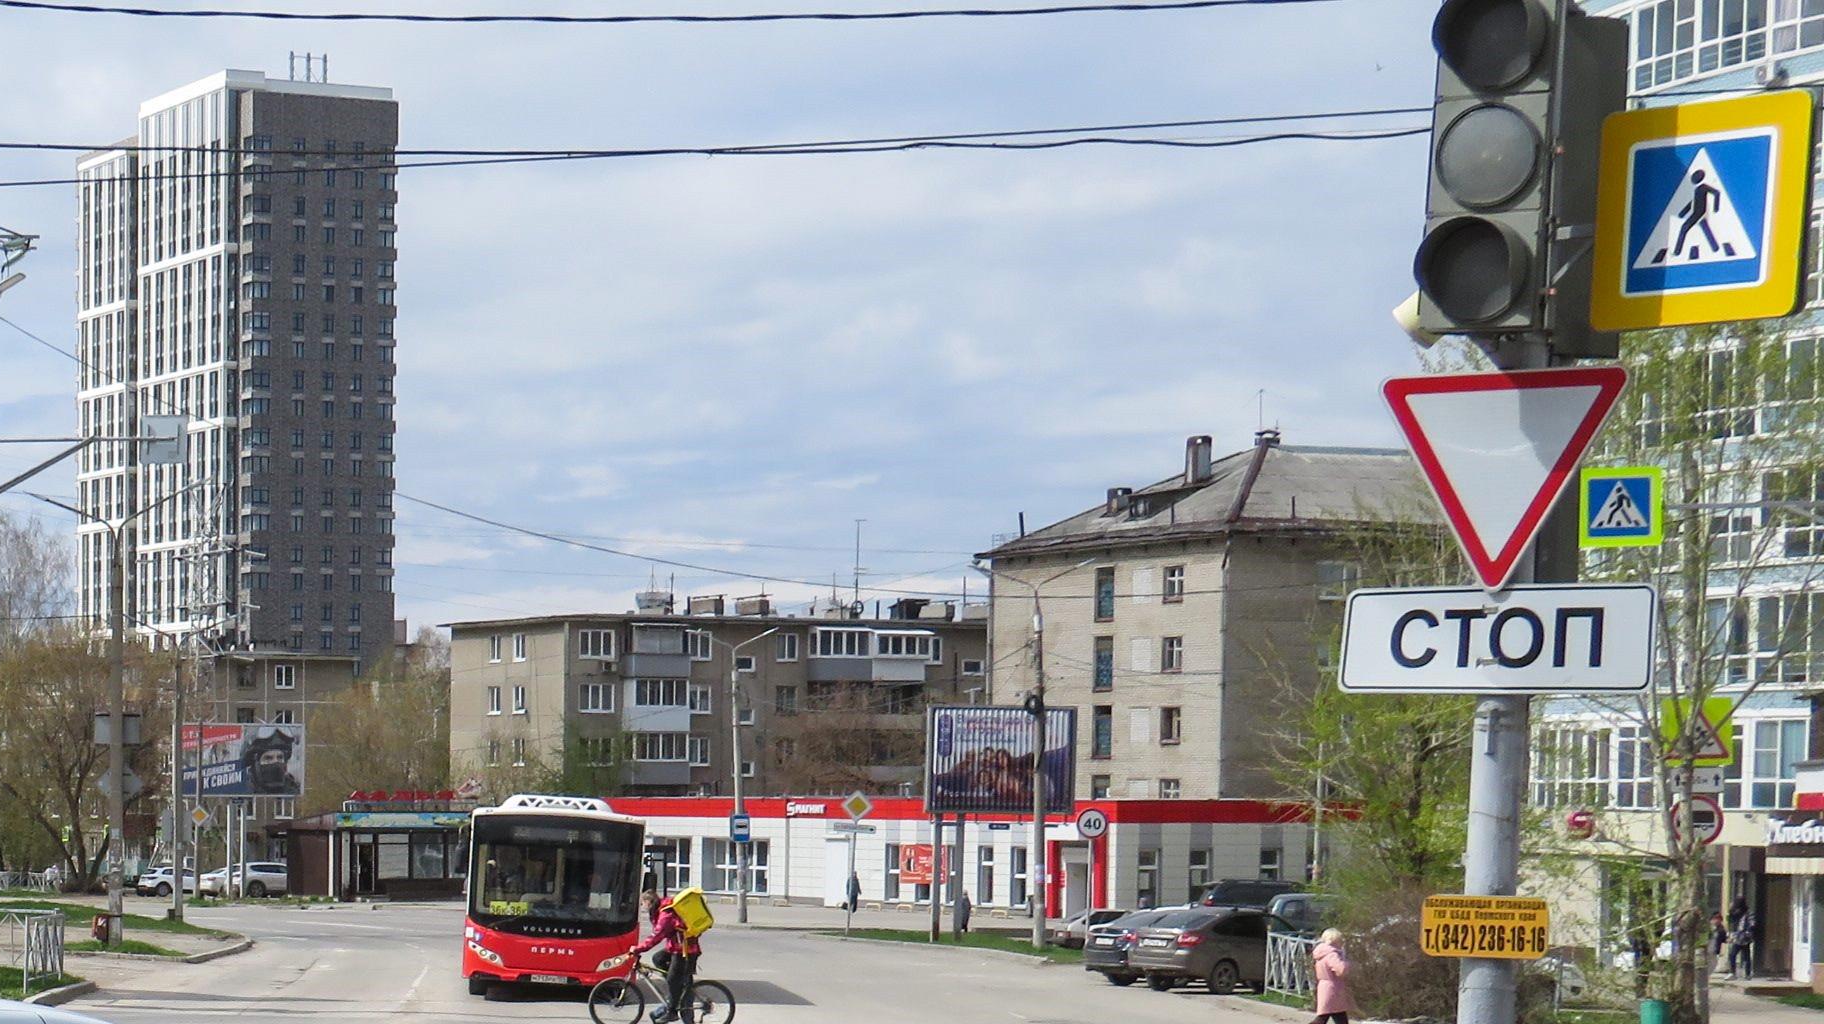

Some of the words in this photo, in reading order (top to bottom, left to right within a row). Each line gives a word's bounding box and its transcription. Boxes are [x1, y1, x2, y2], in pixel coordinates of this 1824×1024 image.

[1390, 607, 1604, 669] СТОП
[211, 771, 242, 787] СВОИМ
[1083, 818, 1102, 830] 40
[1478, 925, 1546, 953] 236-16-16
[531, 946, 574, 955] ПЕРМЬ
